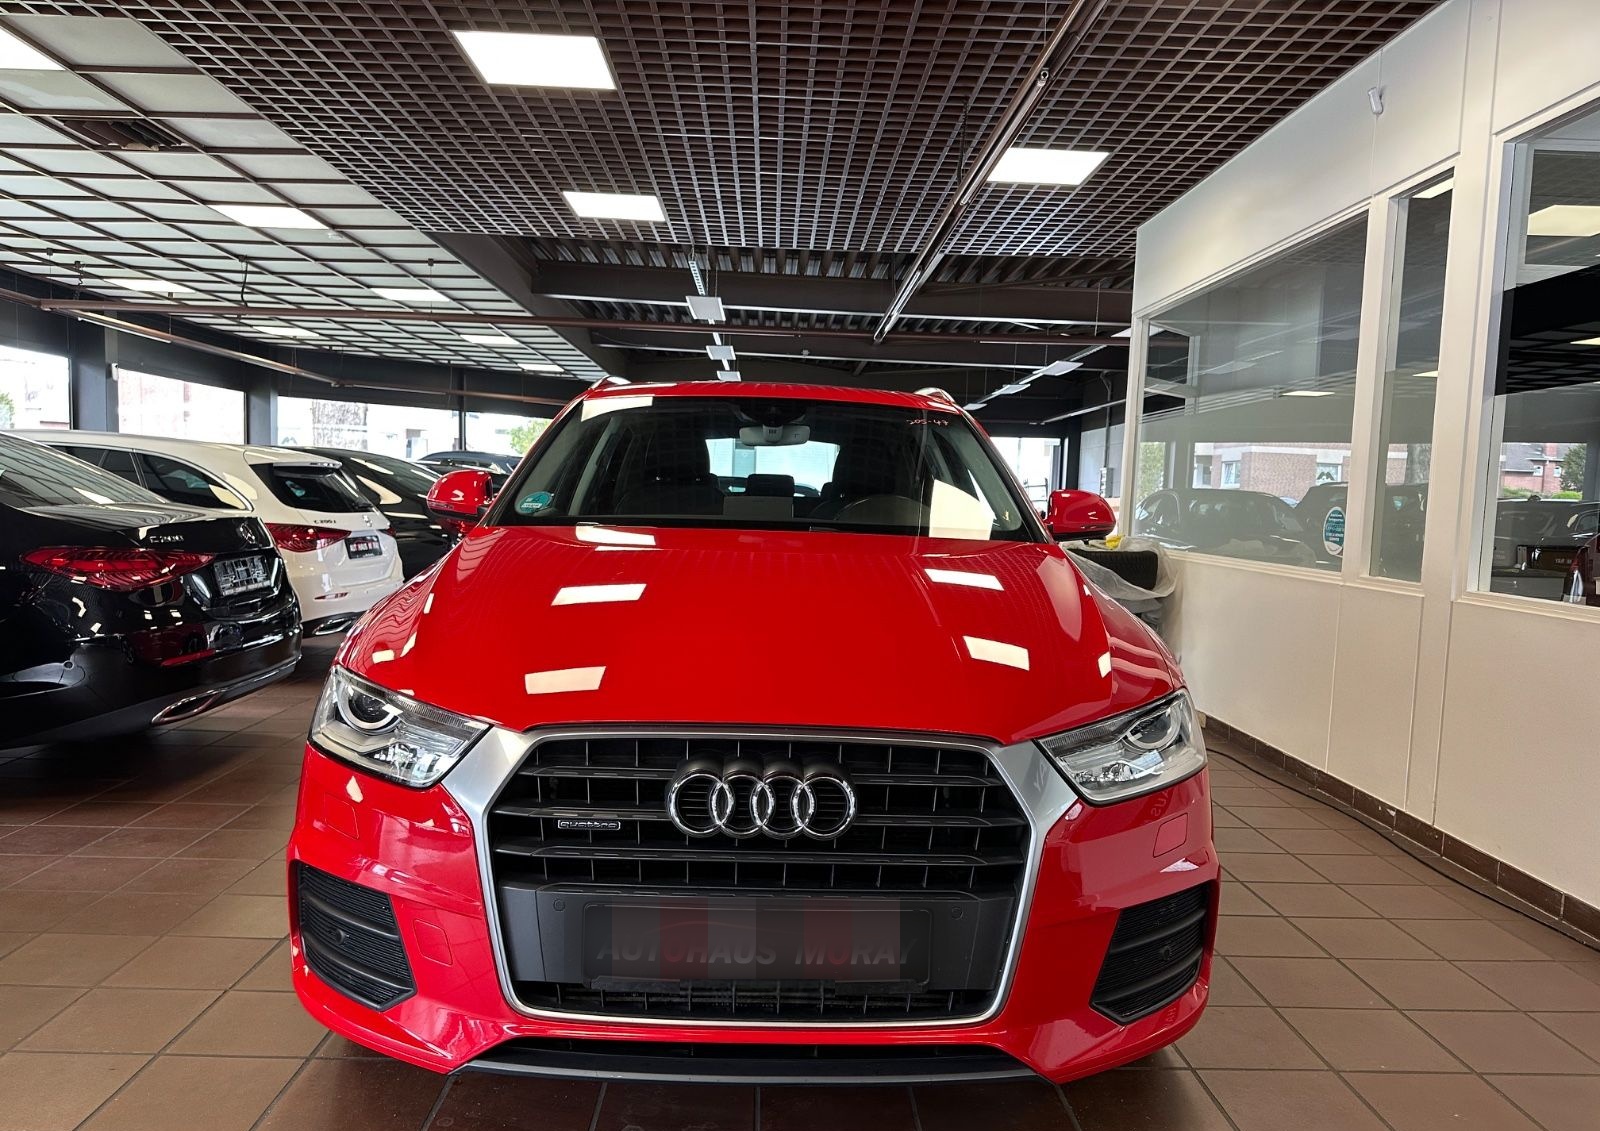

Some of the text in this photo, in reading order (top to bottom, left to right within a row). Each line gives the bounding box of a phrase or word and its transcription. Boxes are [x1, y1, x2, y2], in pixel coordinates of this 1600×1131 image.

[560, 820, 618, 830] quattro
[596, 937, 919, 965] AUTOHAUS MORAY
